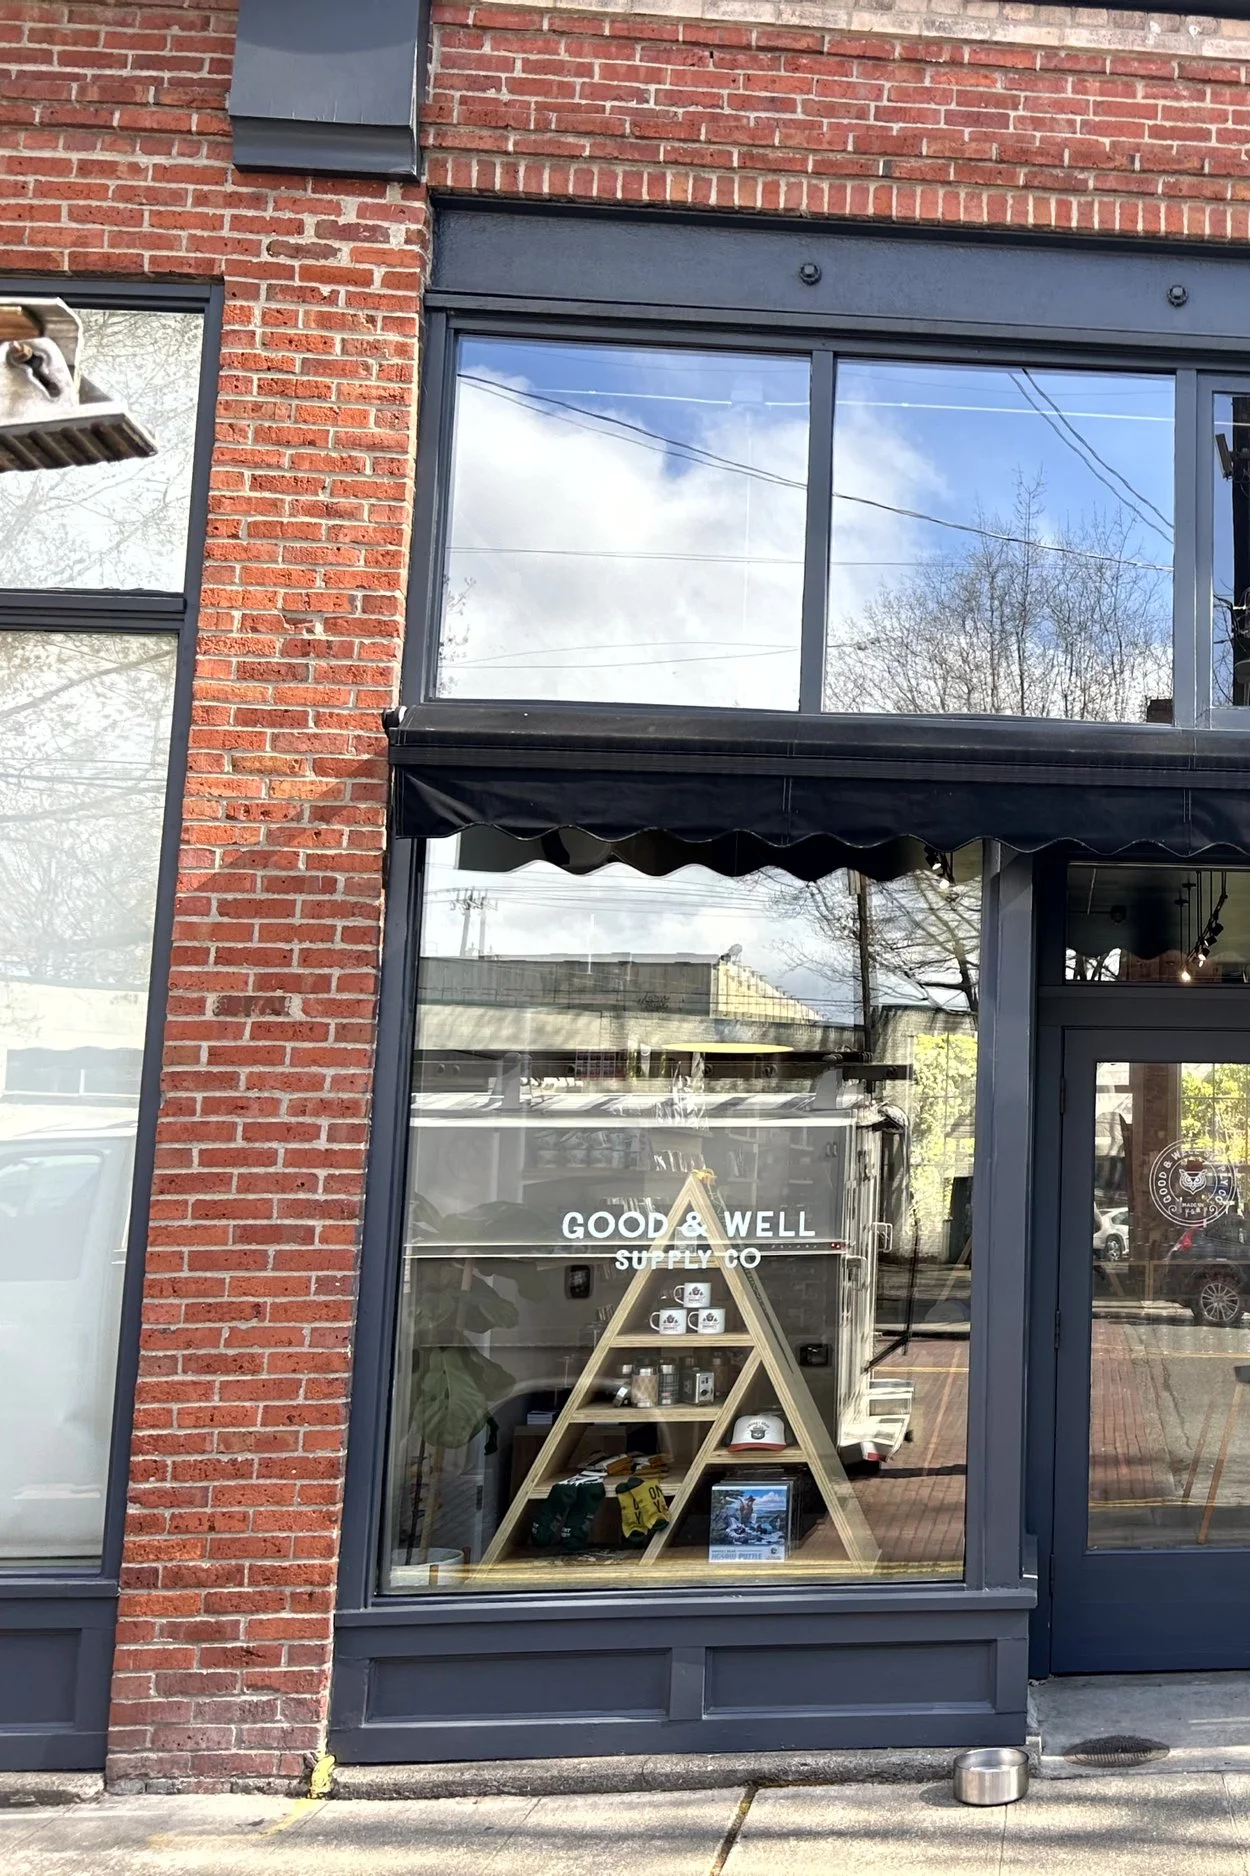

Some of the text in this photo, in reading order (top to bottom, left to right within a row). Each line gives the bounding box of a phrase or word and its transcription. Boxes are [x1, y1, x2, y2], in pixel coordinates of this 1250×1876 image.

[1158, 1171, 1172, 1204] GOOD
[562, 1211, 816, 1239] GOOD & WELL
[615, 1247, 761, 1270] SUPPLY CO
[738, 1552, 763, 1561] PUZZLE
